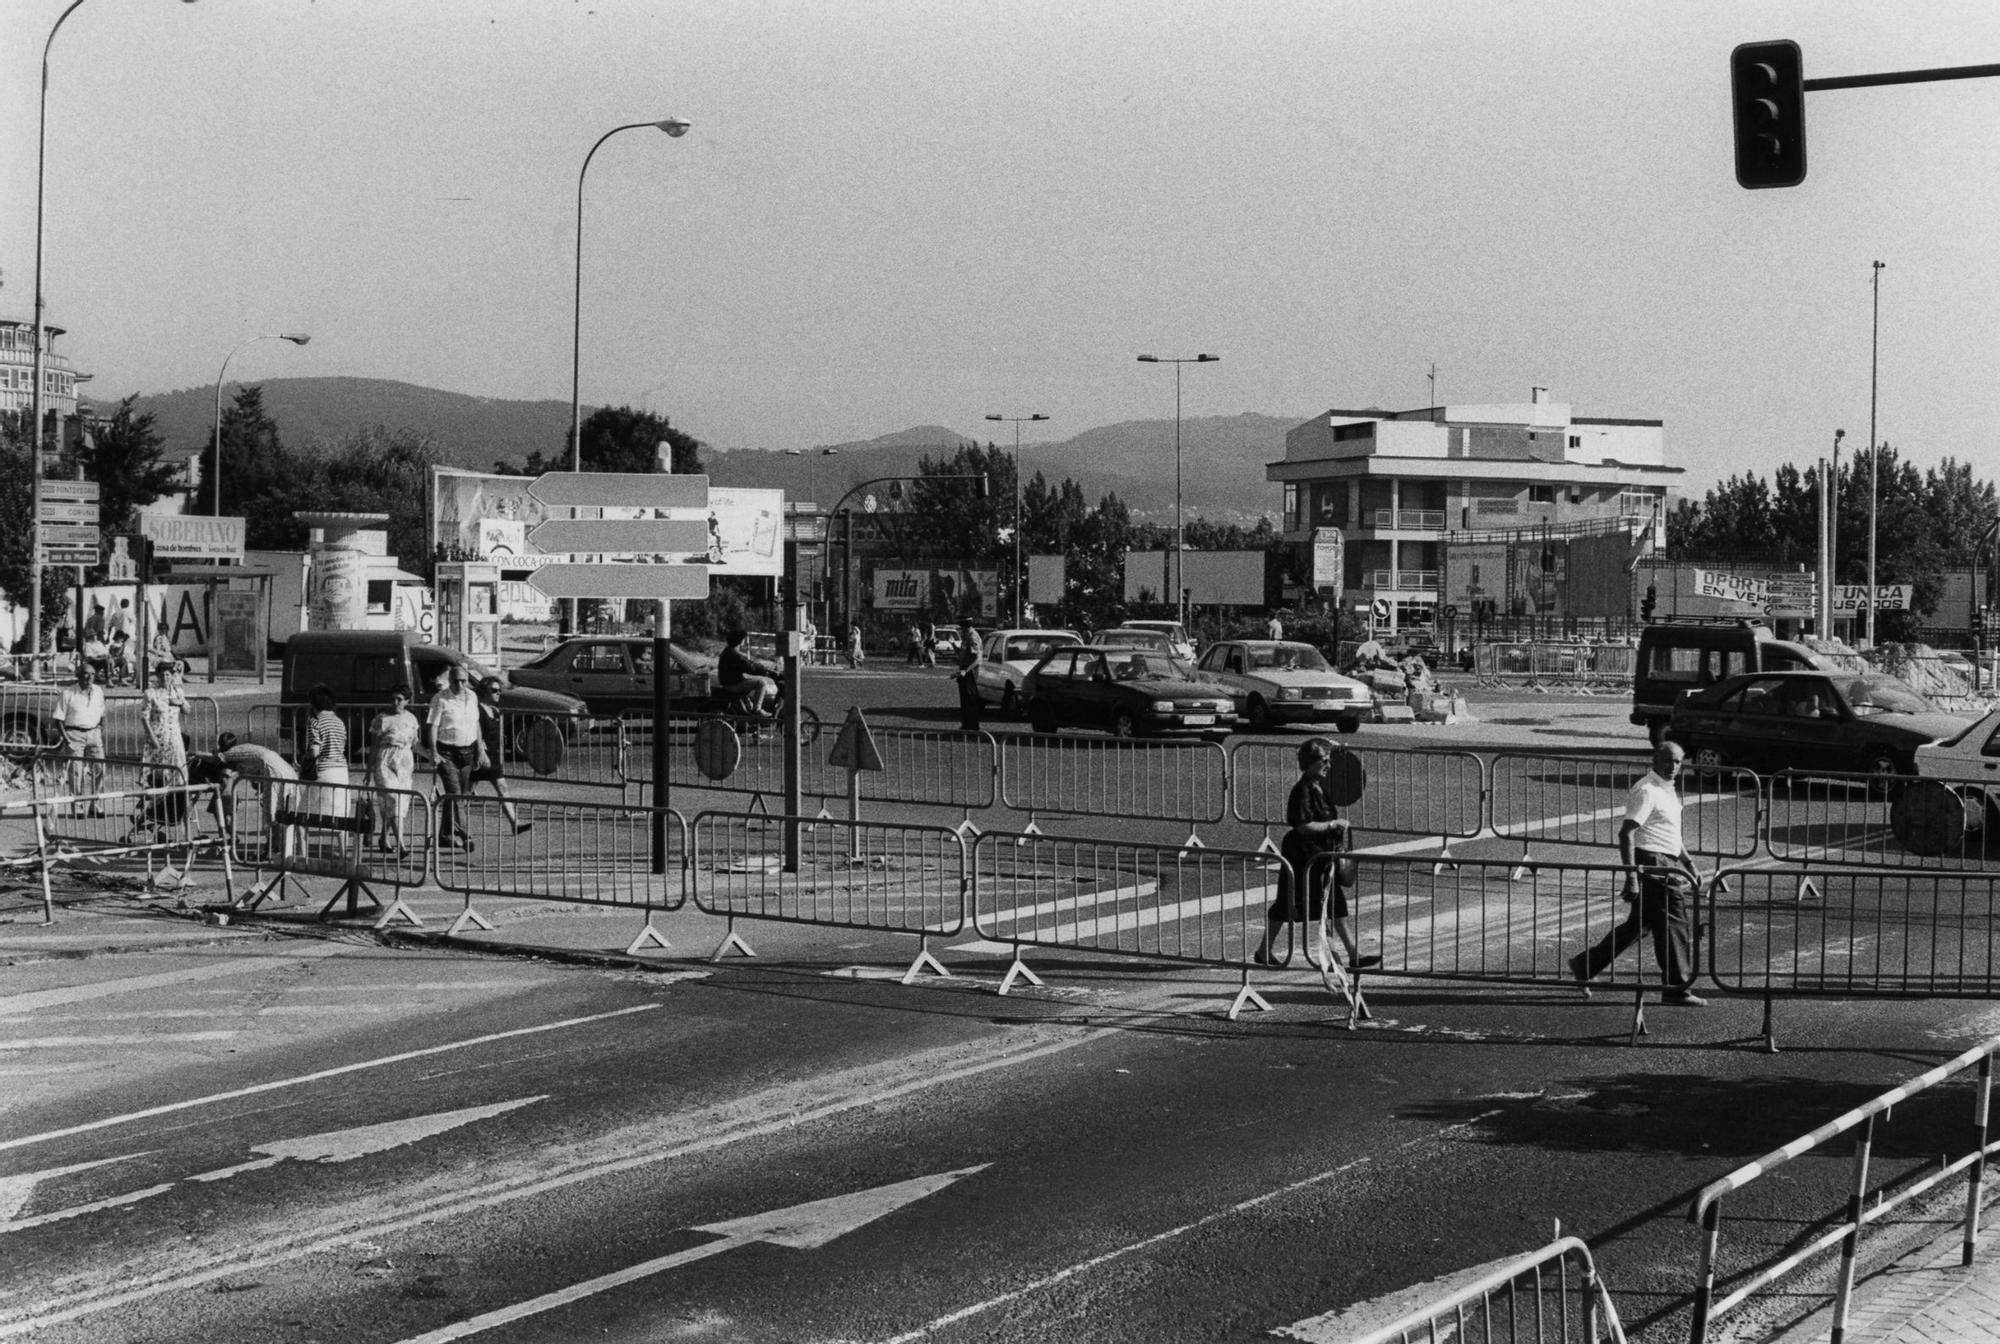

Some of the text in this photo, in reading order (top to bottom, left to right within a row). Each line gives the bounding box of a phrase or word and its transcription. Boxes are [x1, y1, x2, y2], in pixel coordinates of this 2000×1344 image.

[148, 519, 237, 544] SOBERANO
[1702, 584, 1725, 597] EN
[1843, 585, 1904, 600] UNCA
